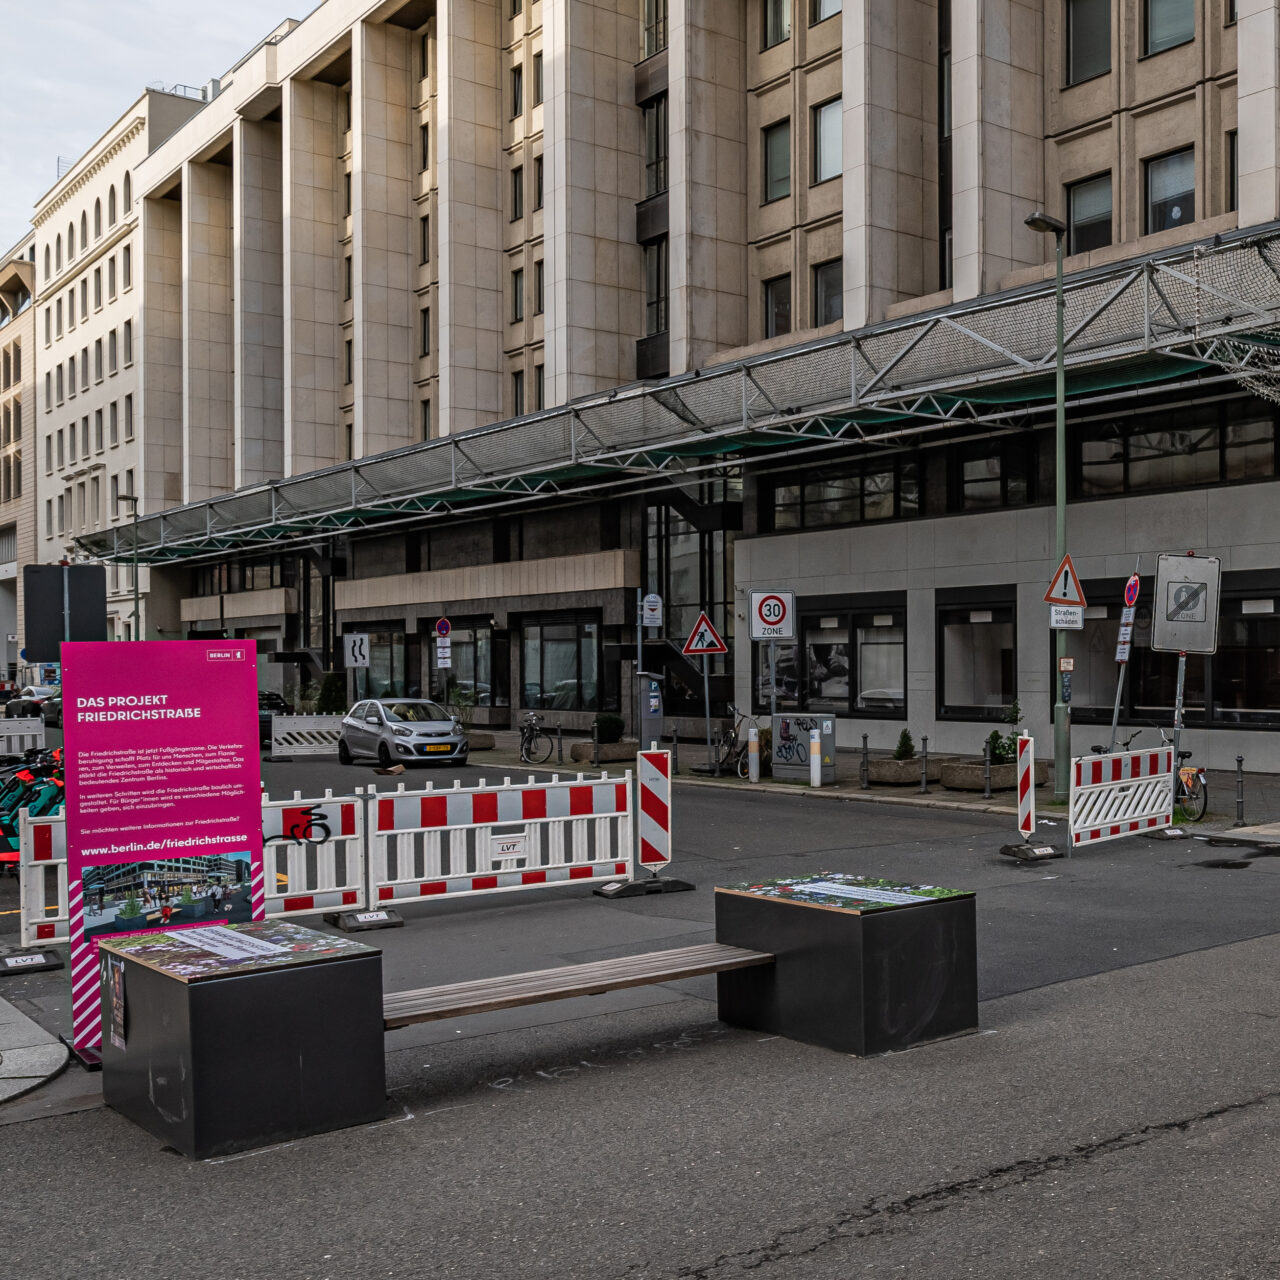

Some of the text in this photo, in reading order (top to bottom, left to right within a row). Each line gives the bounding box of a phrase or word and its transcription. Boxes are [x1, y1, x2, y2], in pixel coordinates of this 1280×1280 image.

[764, 604, 781, 618] 30
[1054, 609, 1079, 617] Straßen-
[1055, 617, 1078, 625] schäden
[762, 627, 783, 635] ZONE
[77, 695, 168, 707] DAS PROJEKT
[77, 707, 201, 722] FRIEDRICHSTRAßE
[81, 833, 248, 856] www.berlin.de/friedrichstrasse
[501, 843, 517, 852] LVT
